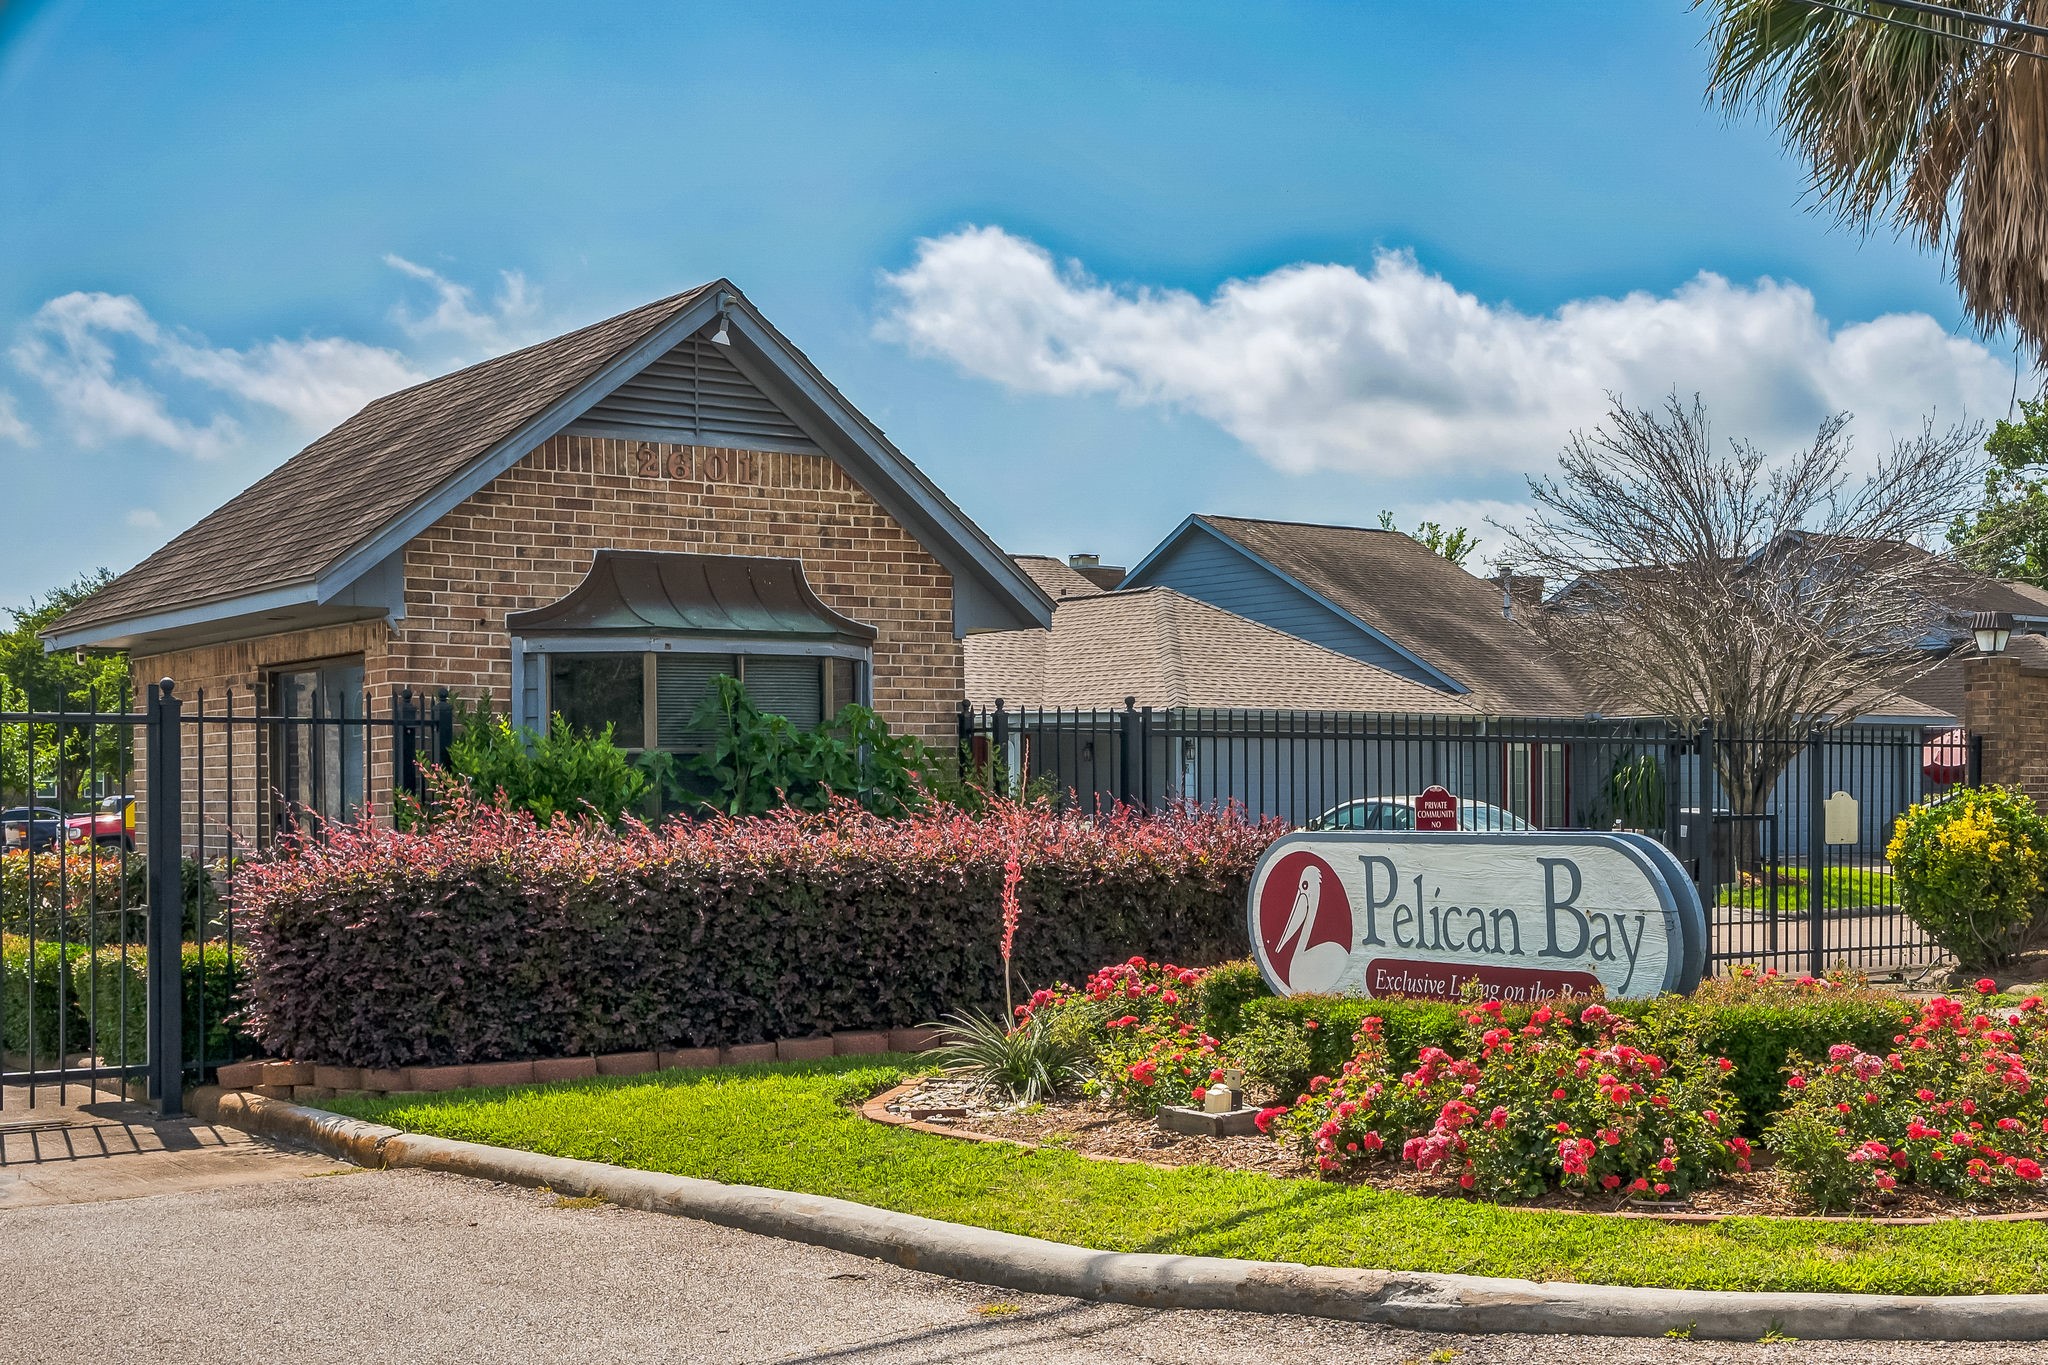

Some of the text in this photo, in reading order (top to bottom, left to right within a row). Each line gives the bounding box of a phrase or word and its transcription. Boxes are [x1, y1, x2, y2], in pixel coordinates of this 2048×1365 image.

[637, 447, 752, 484] 2601
[1417, 810, 1455, 819] COMMUNITY
[1424, 801, 1448, 810] PRIVATE
[1431, 821, 1442, 829] NO
[1358, 855, 1646, 995] Pelican Bay
[1375, 968, 1446, 995] Exclusive
[1504, 985, 1525, 1001] on
[1530, 981, 1555, 1002] the
